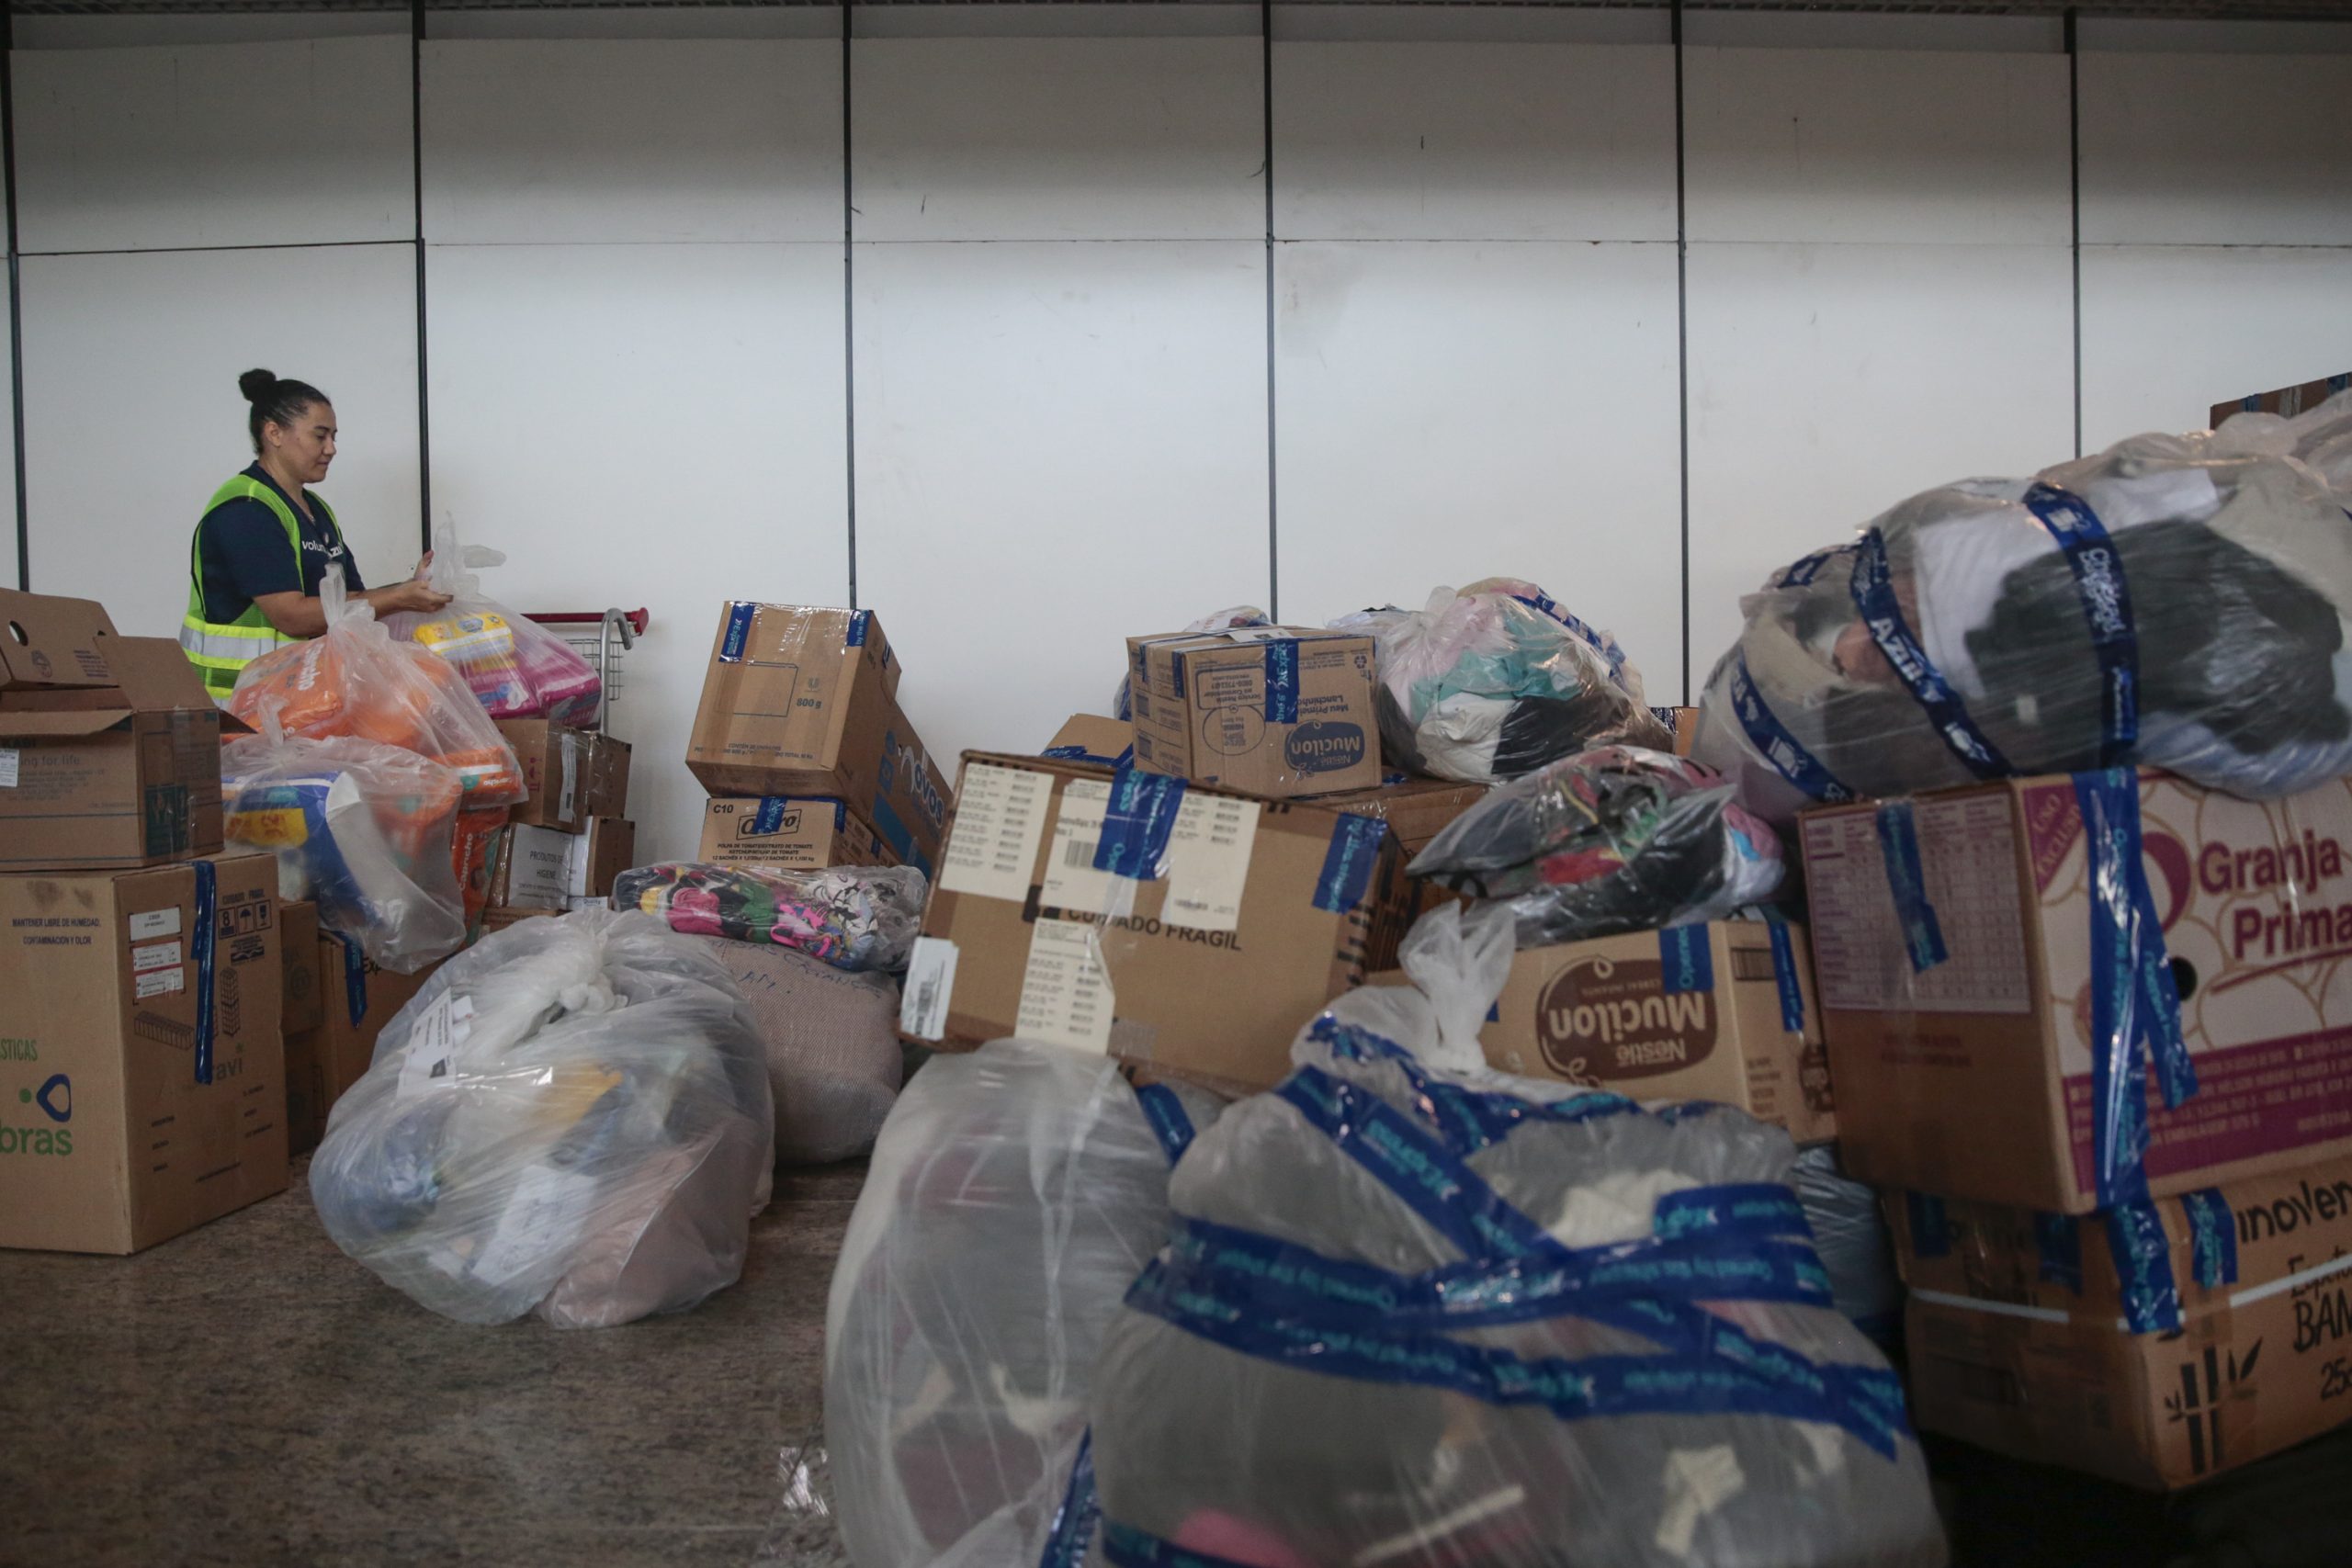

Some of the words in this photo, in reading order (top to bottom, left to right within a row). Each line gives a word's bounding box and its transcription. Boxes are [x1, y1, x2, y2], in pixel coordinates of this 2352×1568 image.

[797, 698, 813, 707] 800
[1291, 736, 1361, 756] Mucilon
[713, 805, 734, 814] C10
[2199, 829, 2343, 895] Granja
[2233, 900, 2352, 959] Prima
[1549, 992, 1706, 1043] Mucilon
